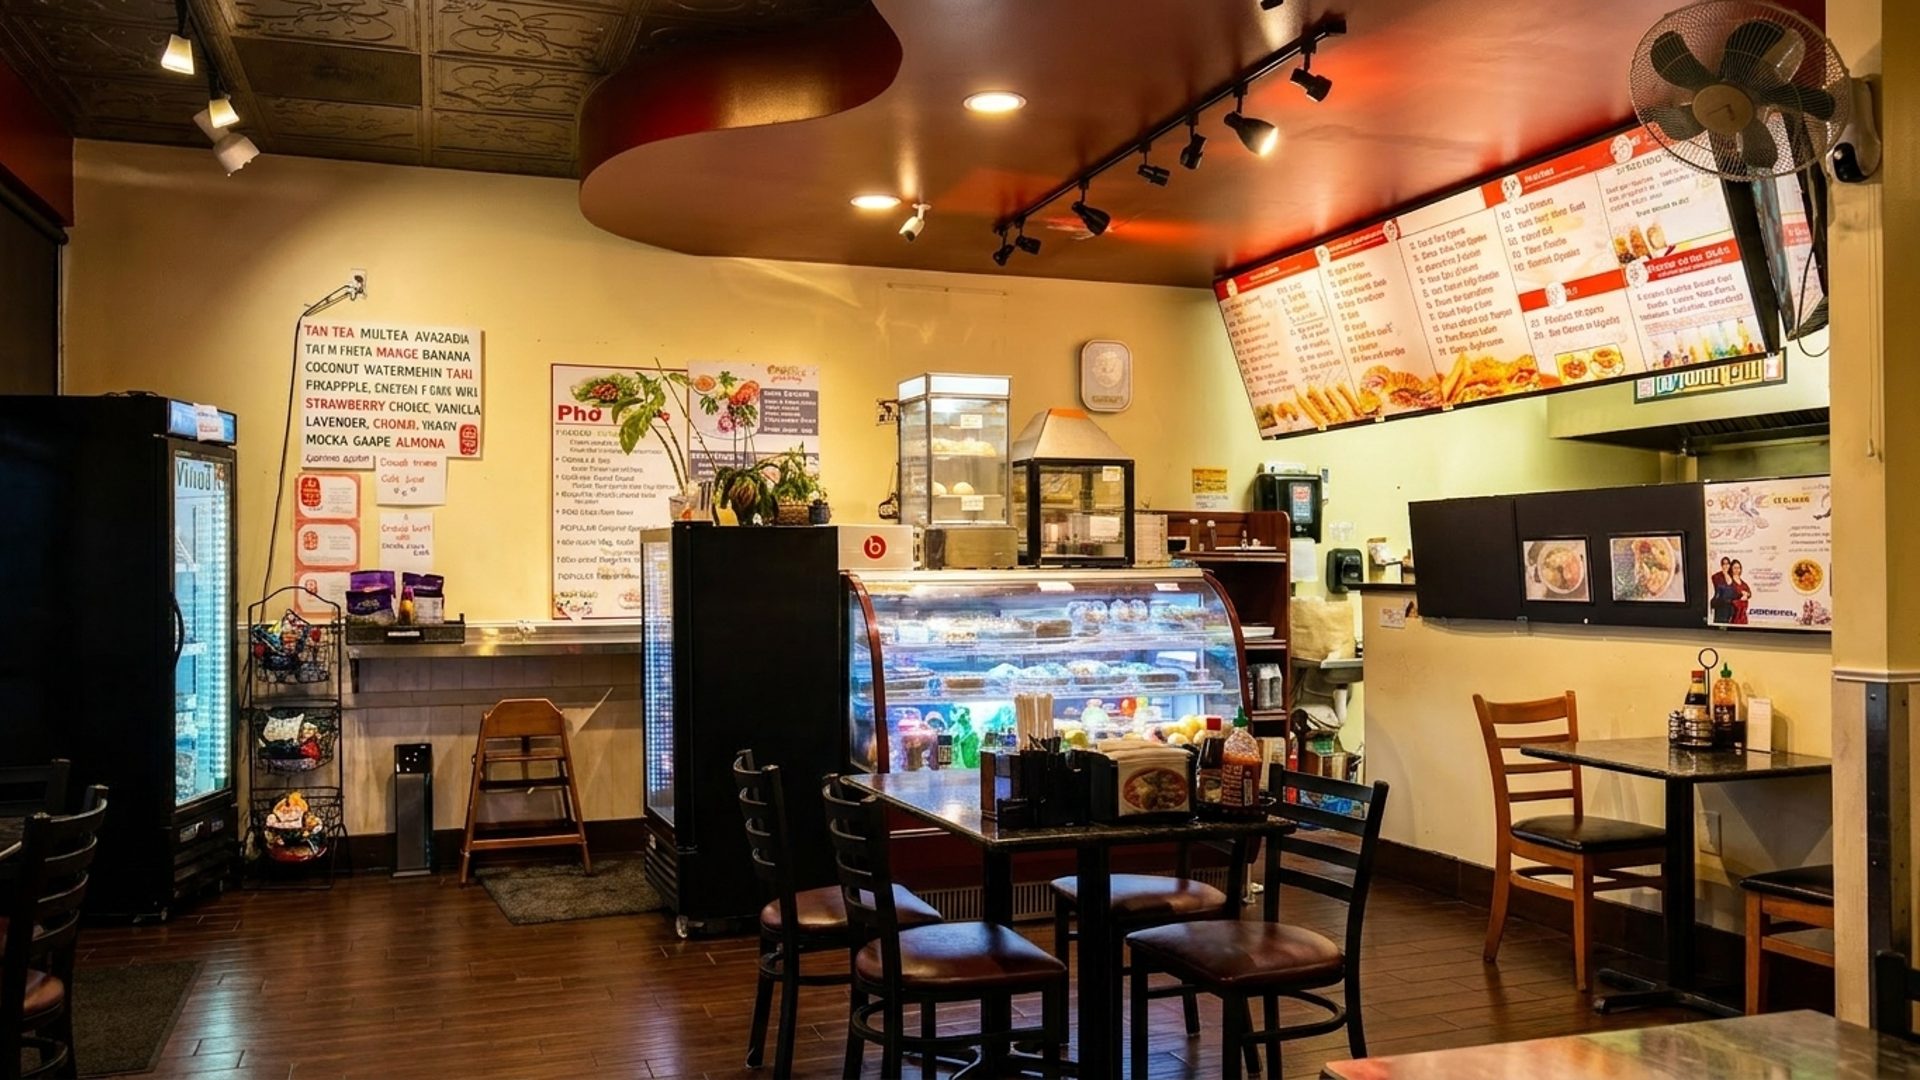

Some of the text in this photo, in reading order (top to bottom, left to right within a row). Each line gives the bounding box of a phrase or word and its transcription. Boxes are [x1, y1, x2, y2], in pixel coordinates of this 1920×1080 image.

[304, 325, 328, 336] TAN
[332, 326, 354, 338] TEA
[360, 328, 408, 341] MULTEA
[422, 349, 471, 362] BANANA
[305, 361, 359, 375] COCONUT
[305, 397, 386, 411] STRAWBERRY
[306, 434, 348, 446] MOCKA
[396, 437, 446, 448] ALMONA
